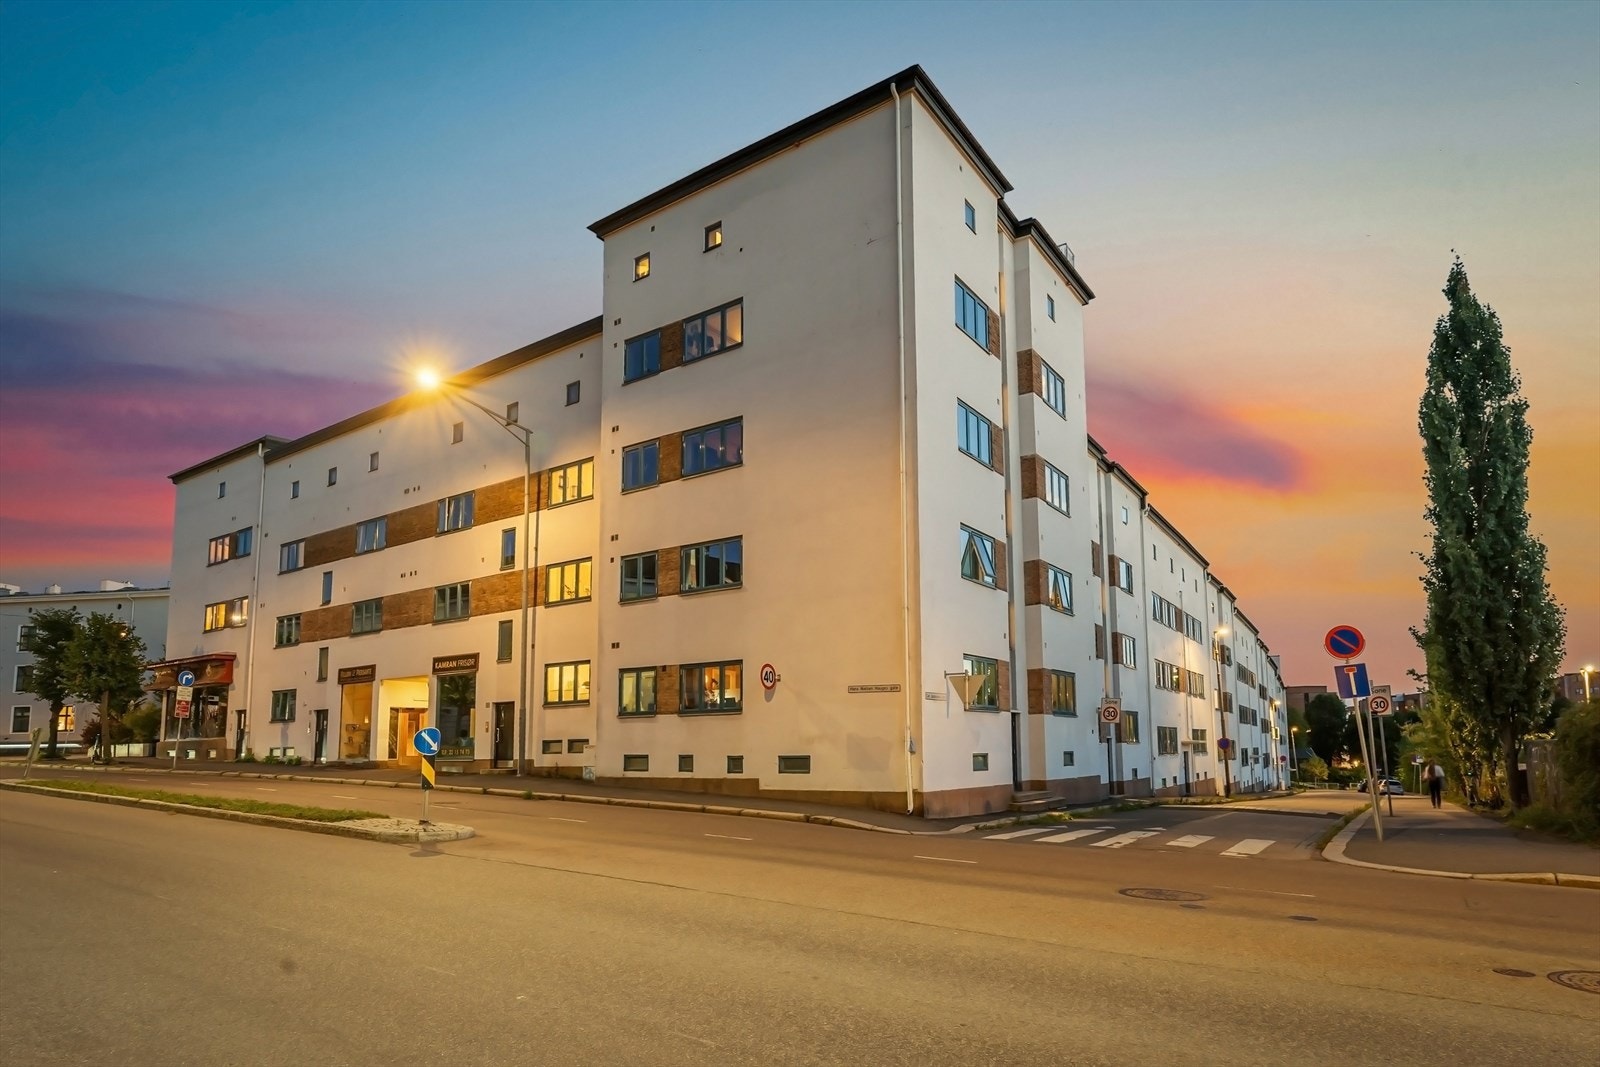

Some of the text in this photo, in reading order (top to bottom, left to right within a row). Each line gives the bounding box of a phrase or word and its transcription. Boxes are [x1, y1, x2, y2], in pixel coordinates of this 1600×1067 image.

[763, 670, 774, 683] 40
[1373, 700, 1386, 709] 30
[1105, 710, 1116, 718] 30
